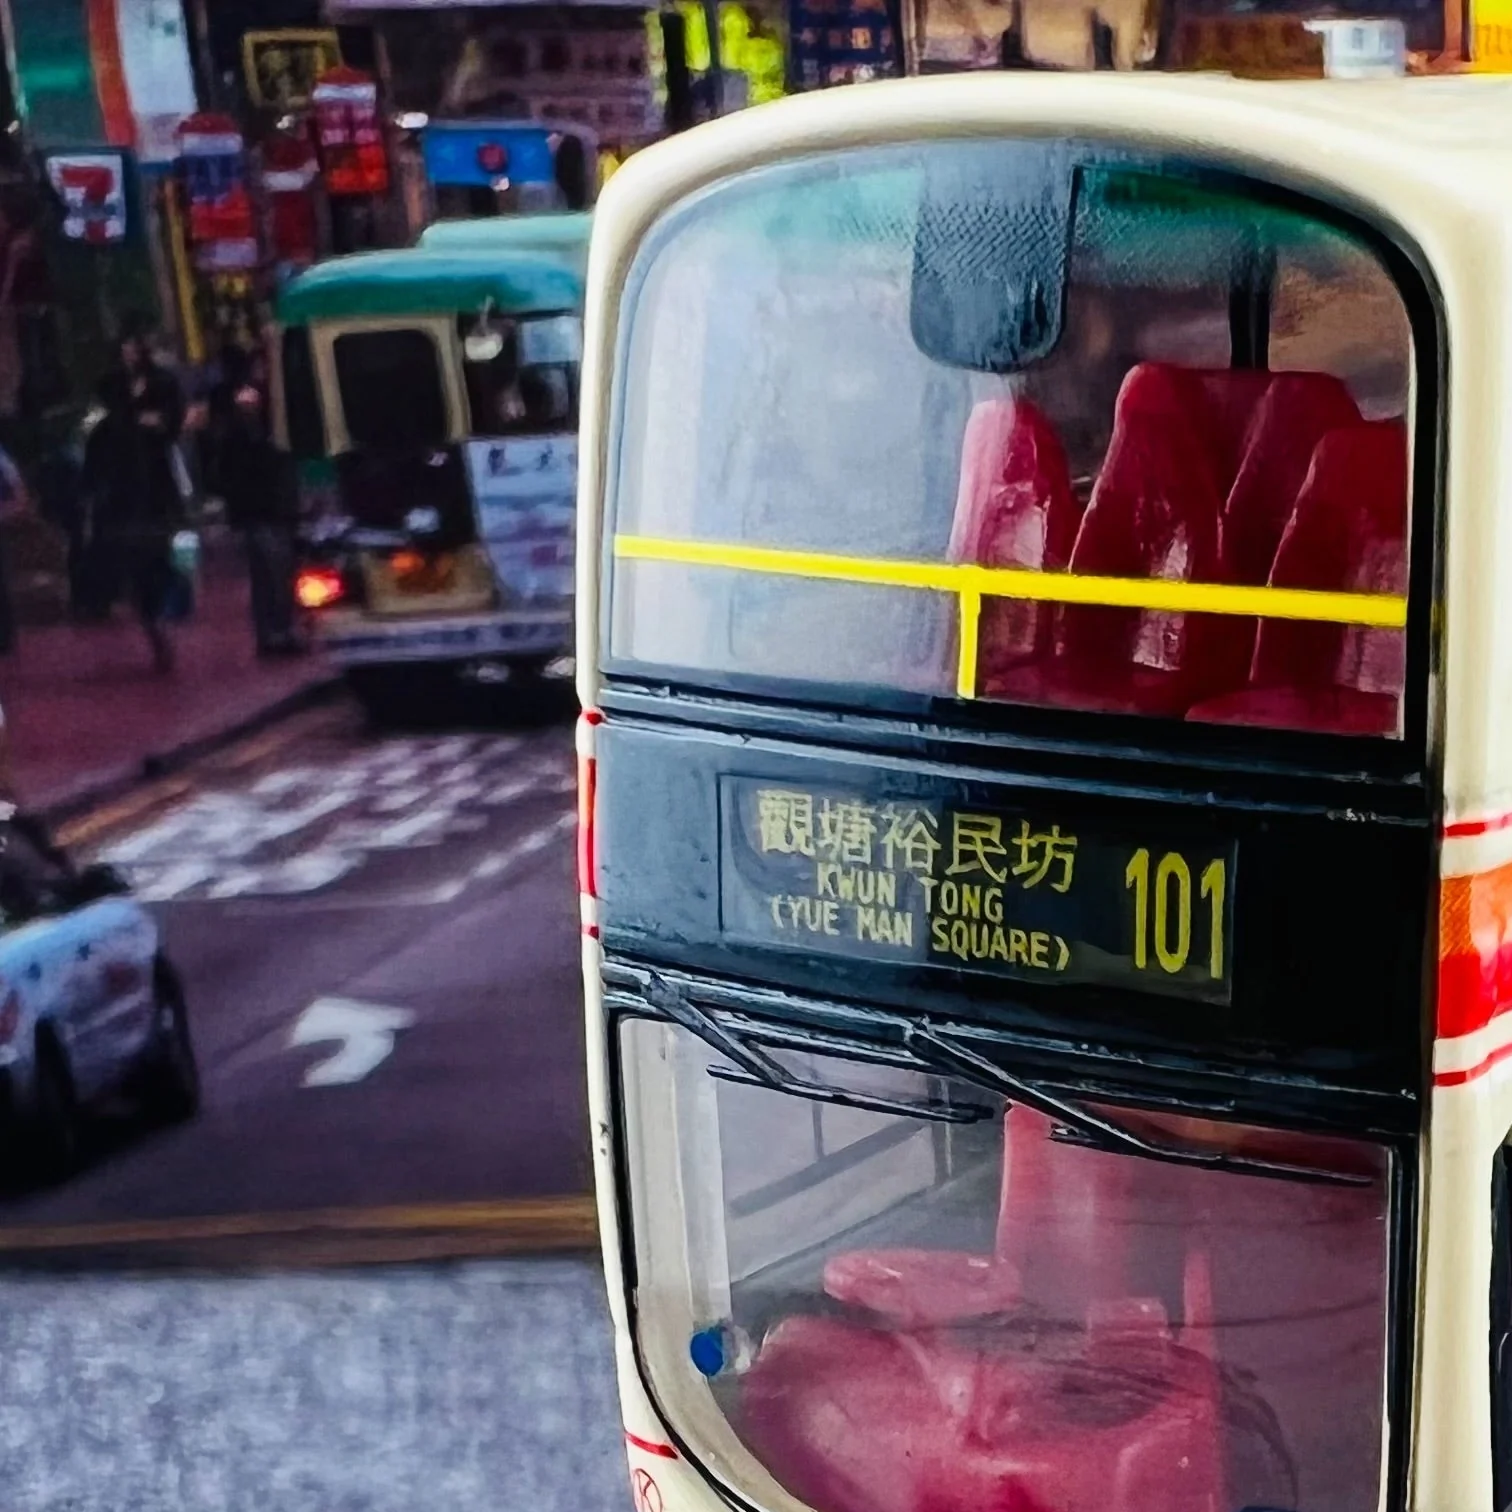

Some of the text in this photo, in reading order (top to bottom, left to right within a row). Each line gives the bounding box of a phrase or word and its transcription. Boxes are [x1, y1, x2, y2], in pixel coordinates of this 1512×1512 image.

[757, 789, 1078, 893] 觀塘裕民坊
[770, 895, 1071, 973] (YUE MAN SQUARE)
[816, 861, 1004, 920] KWUN TONG
[1125, 847, 1226, 980] 101
